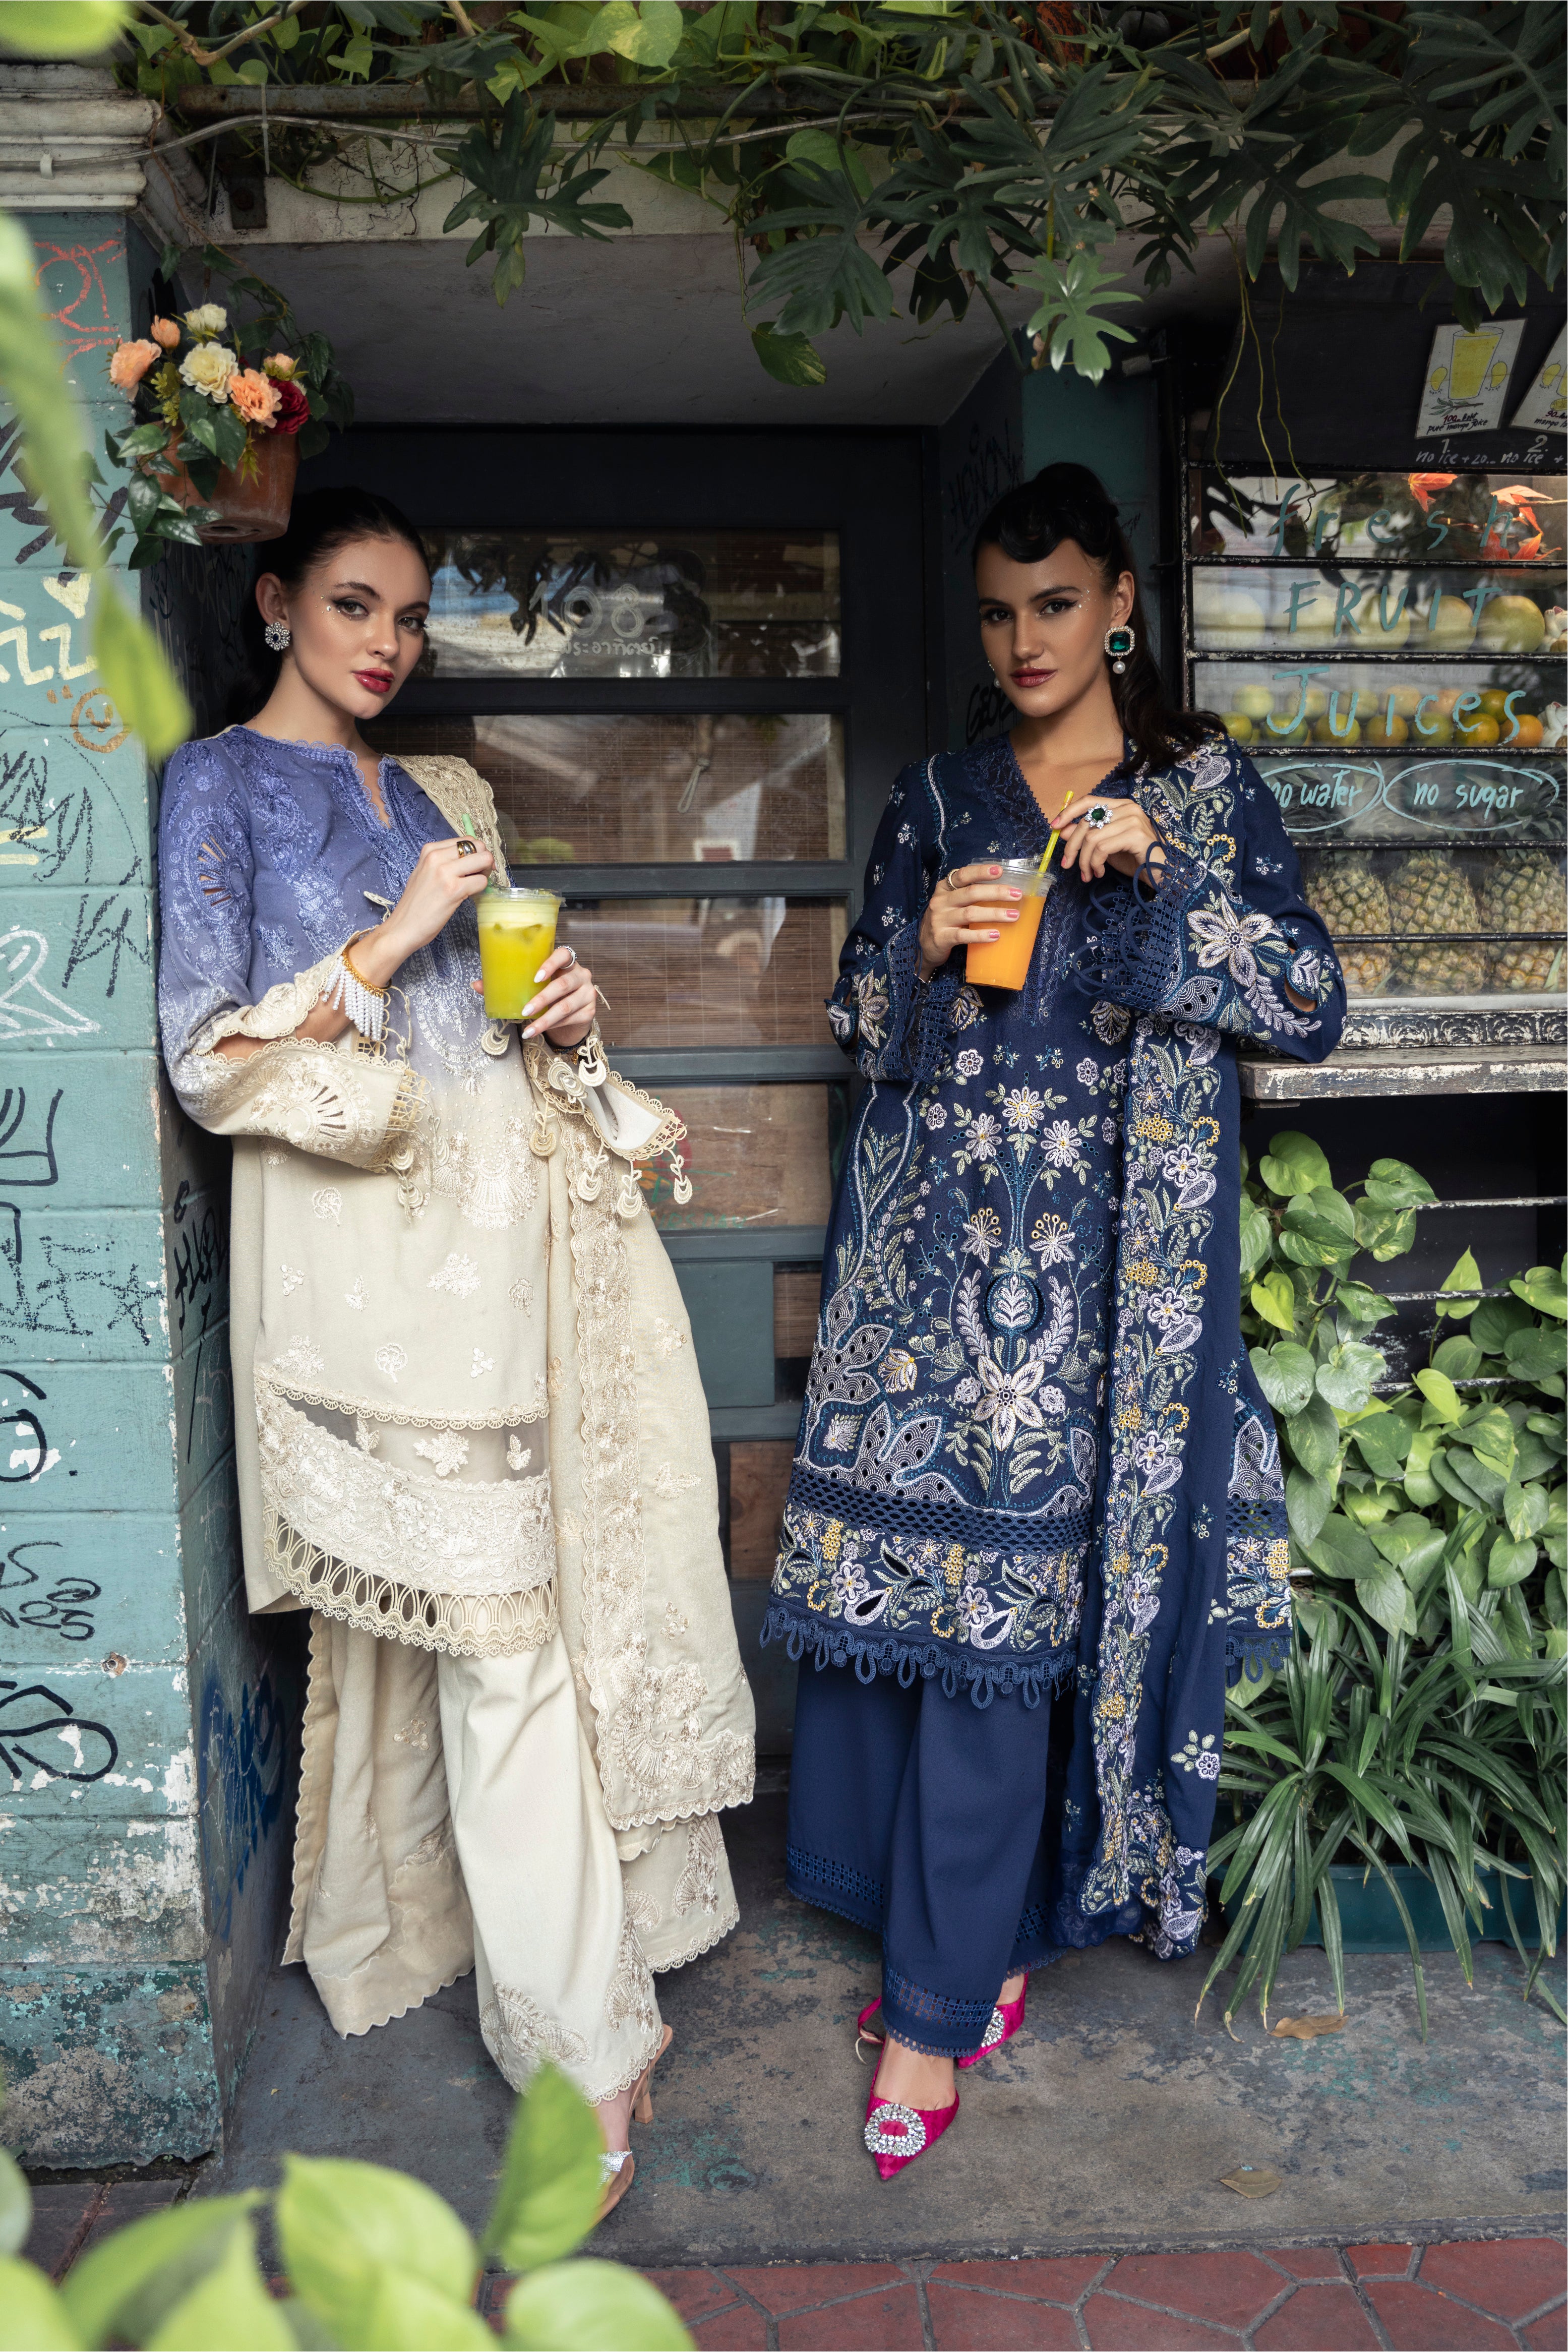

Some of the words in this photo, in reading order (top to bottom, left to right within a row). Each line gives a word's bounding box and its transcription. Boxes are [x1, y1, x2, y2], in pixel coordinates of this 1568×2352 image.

[1426, 425, 1444, 435] pure
[1438, 453, 1459, 465] ice
[1523, 453, 1544, 464] ice
[1270, 484, 1514, 557] fresh
[528, 581, 644, 638] 108
[1284, 580, 1503, 637] FRUIT
[561, 637, 658, 656] พระอาทิตย์
[1266, 666, 1526, 746] Juices
[1413, 782, 1439, 806] no
[1456, 784, 1524, 820] sugar
